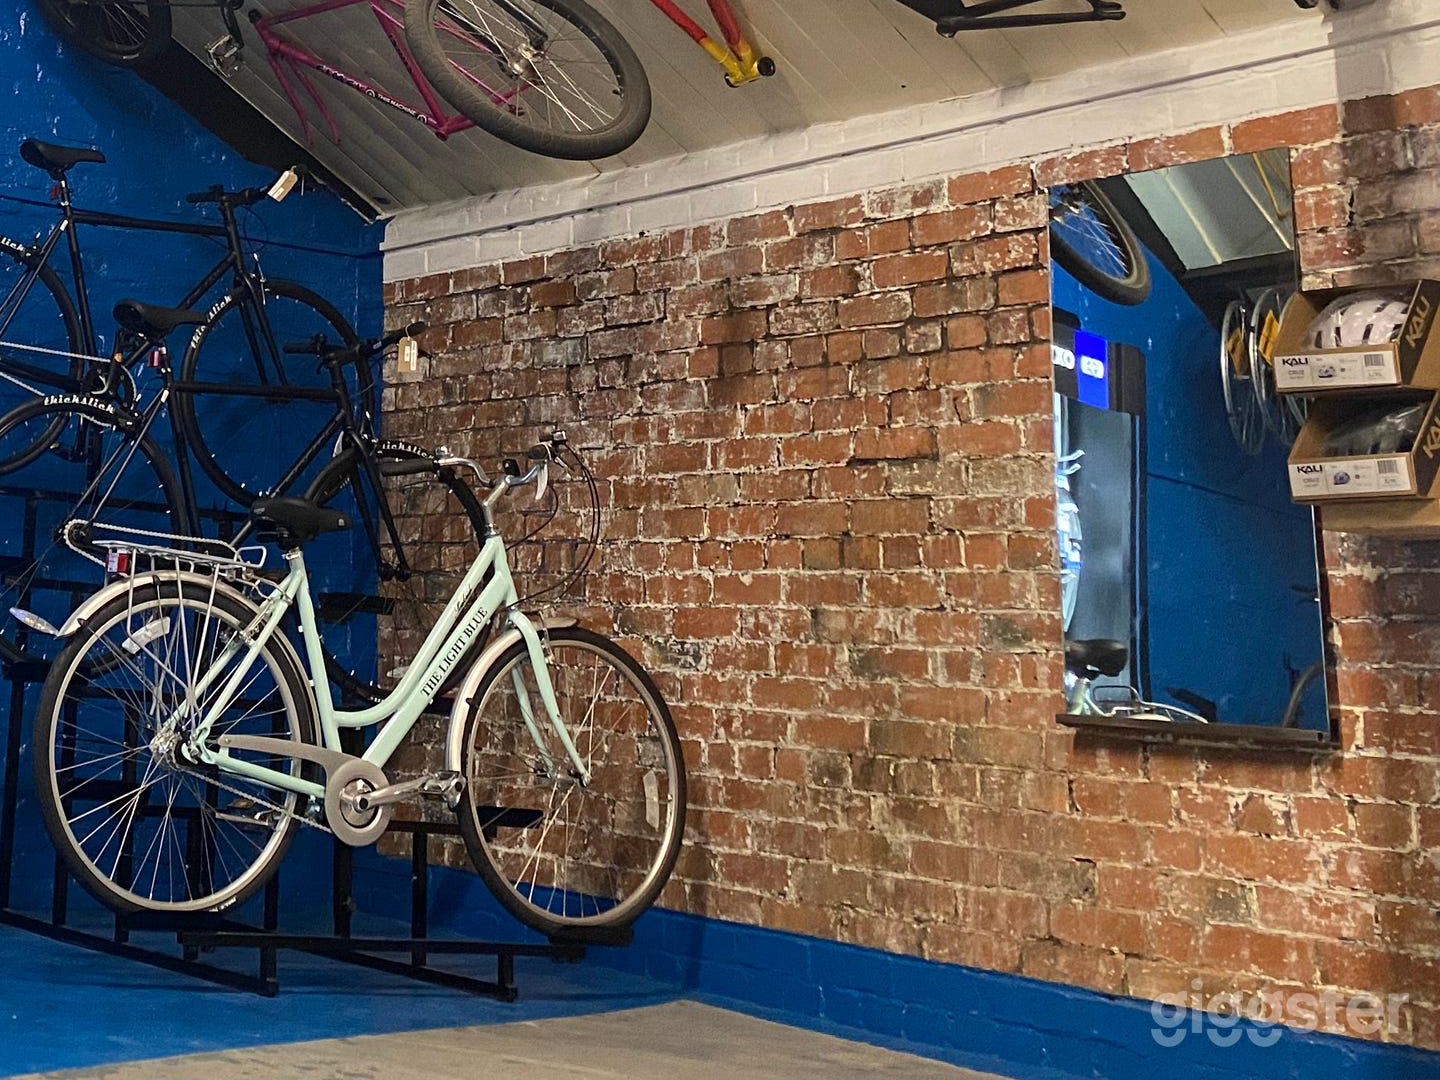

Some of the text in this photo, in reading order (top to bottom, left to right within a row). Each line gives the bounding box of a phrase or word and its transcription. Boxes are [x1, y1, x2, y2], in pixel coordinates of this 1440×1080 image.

[1404, 295, 1432, 350] KALI
[1282, 357, 1309, 367] KALI
[43, 394, 116, 415] thickslick
[1296, 464, 1323, 474] KALI
[420, 671, 443, 697] THE
[437, 634, 467, 675] LIGHT
[465, 607, 489, 640] BLUE
